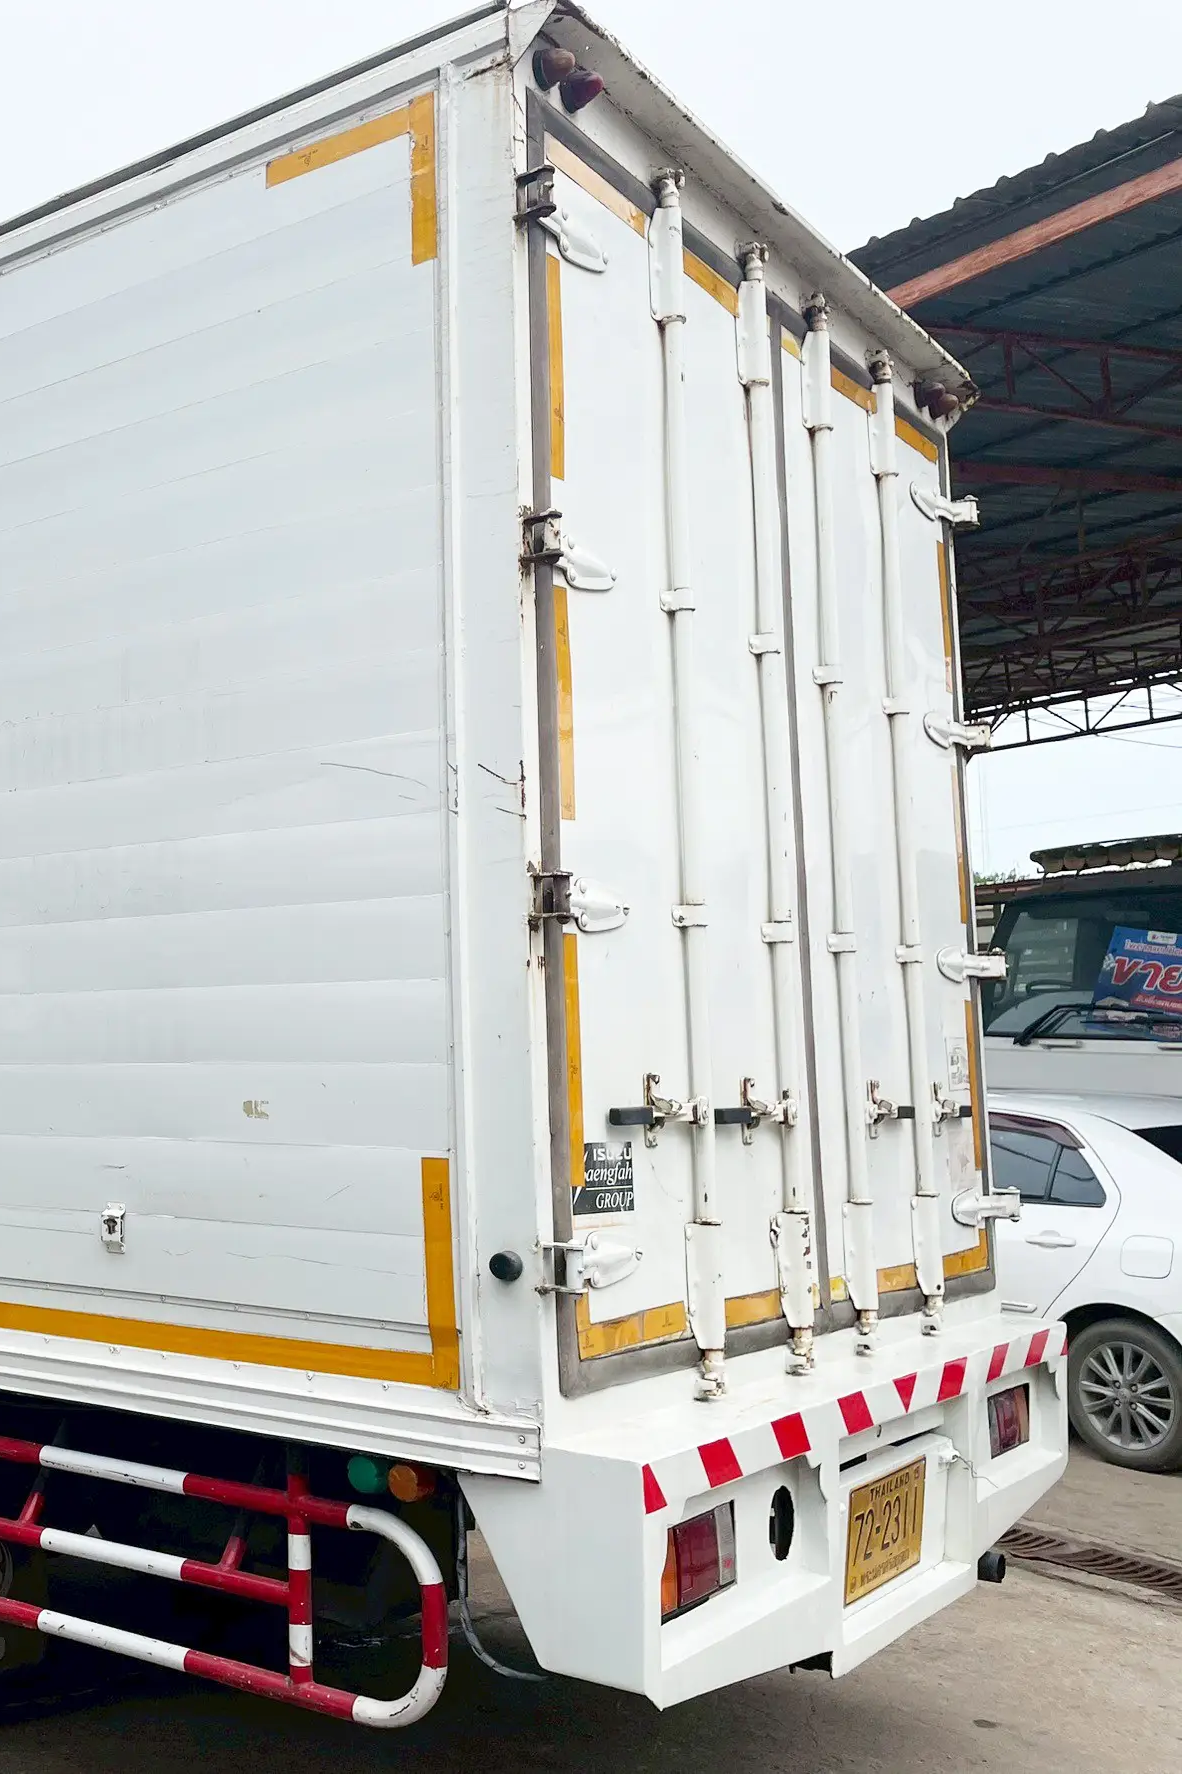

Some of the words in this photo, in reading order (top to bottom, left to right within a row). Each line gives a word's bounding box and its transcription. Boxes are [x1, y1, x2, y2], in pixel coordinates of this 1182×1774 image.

[584, 1162, 632, 1185] aengfah
[596, 1191, 634, 1209] GROUP
[870, 1472, 910, 1501] THAILAND
[852, 1486, 918, 1567] 72-2311
